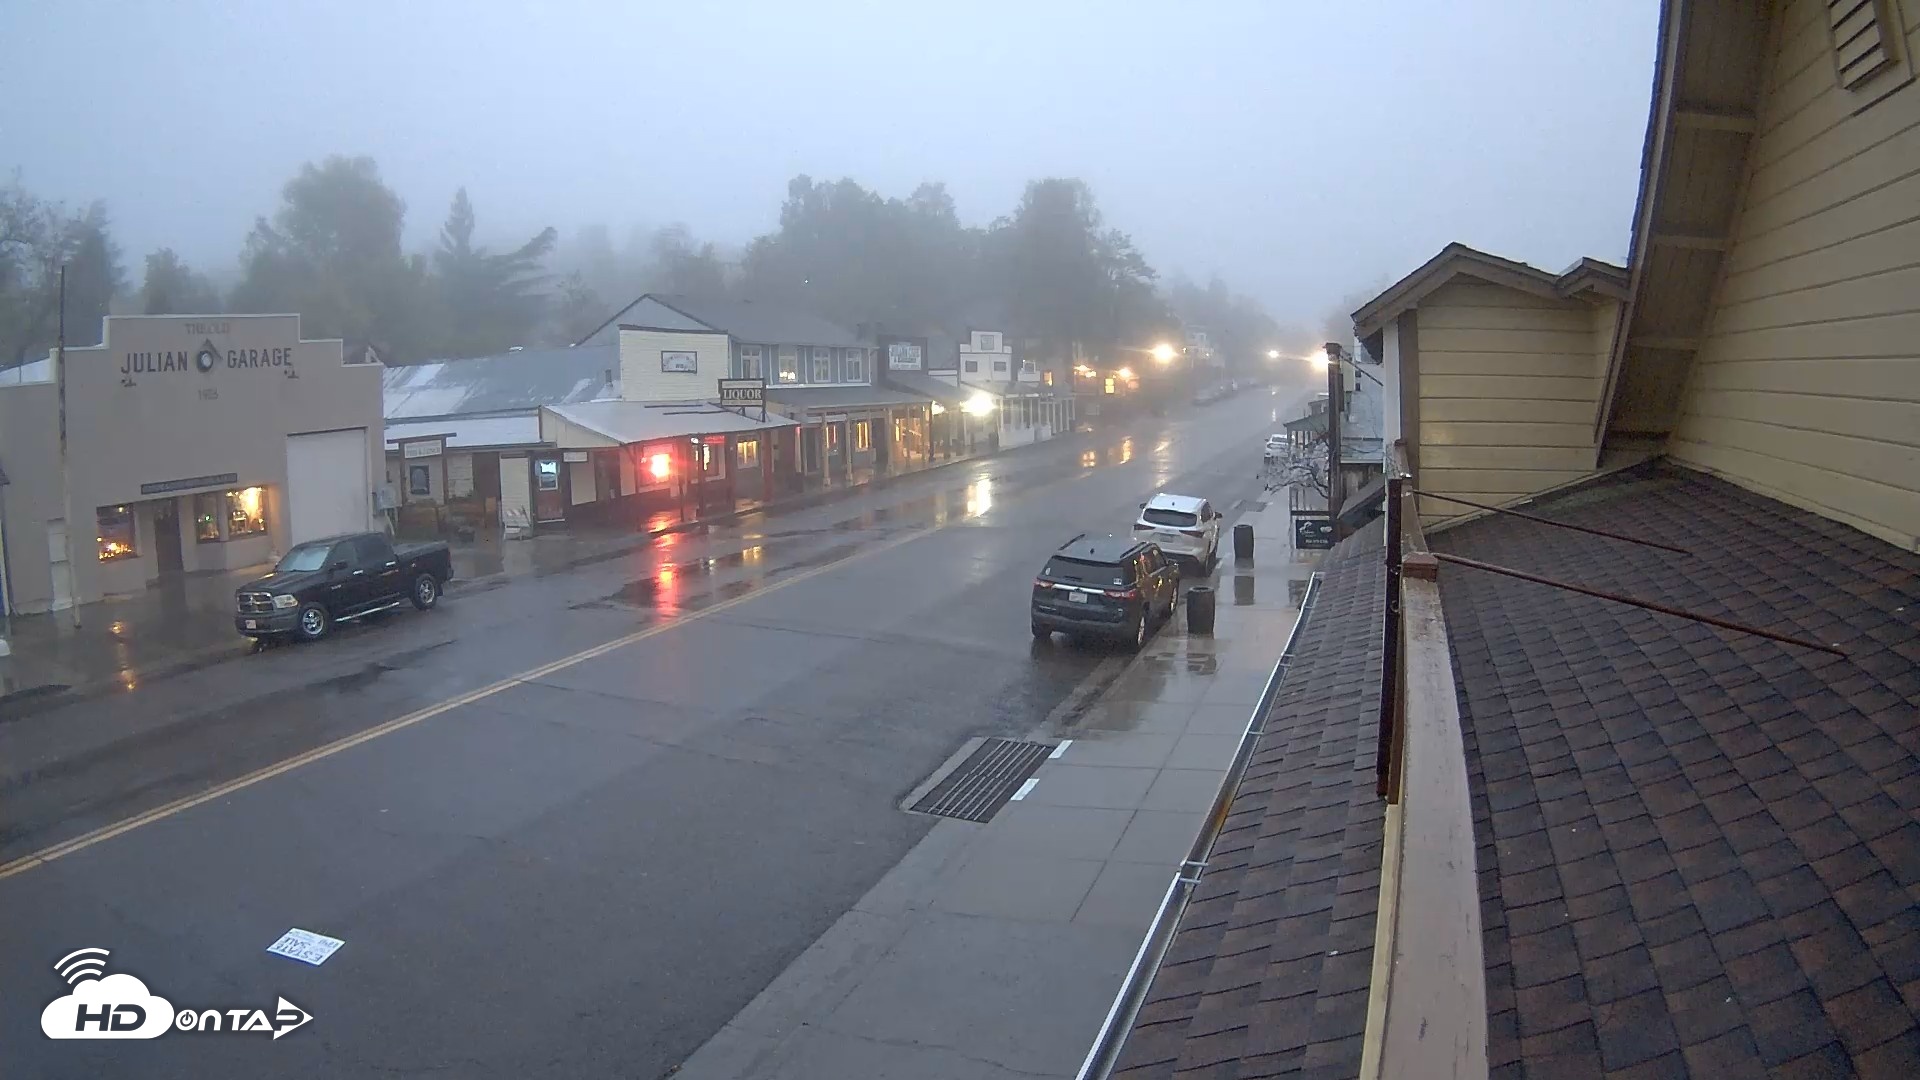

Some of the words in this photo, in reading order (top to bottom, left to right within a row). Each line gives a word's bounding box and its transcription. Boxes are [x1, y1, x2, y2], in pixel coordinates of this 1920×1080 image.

[120, 352, 188, 374] JULIAN
[227, 348, 292, 368] GARAGE
[723, 388, 762, 400] LIQUOR
